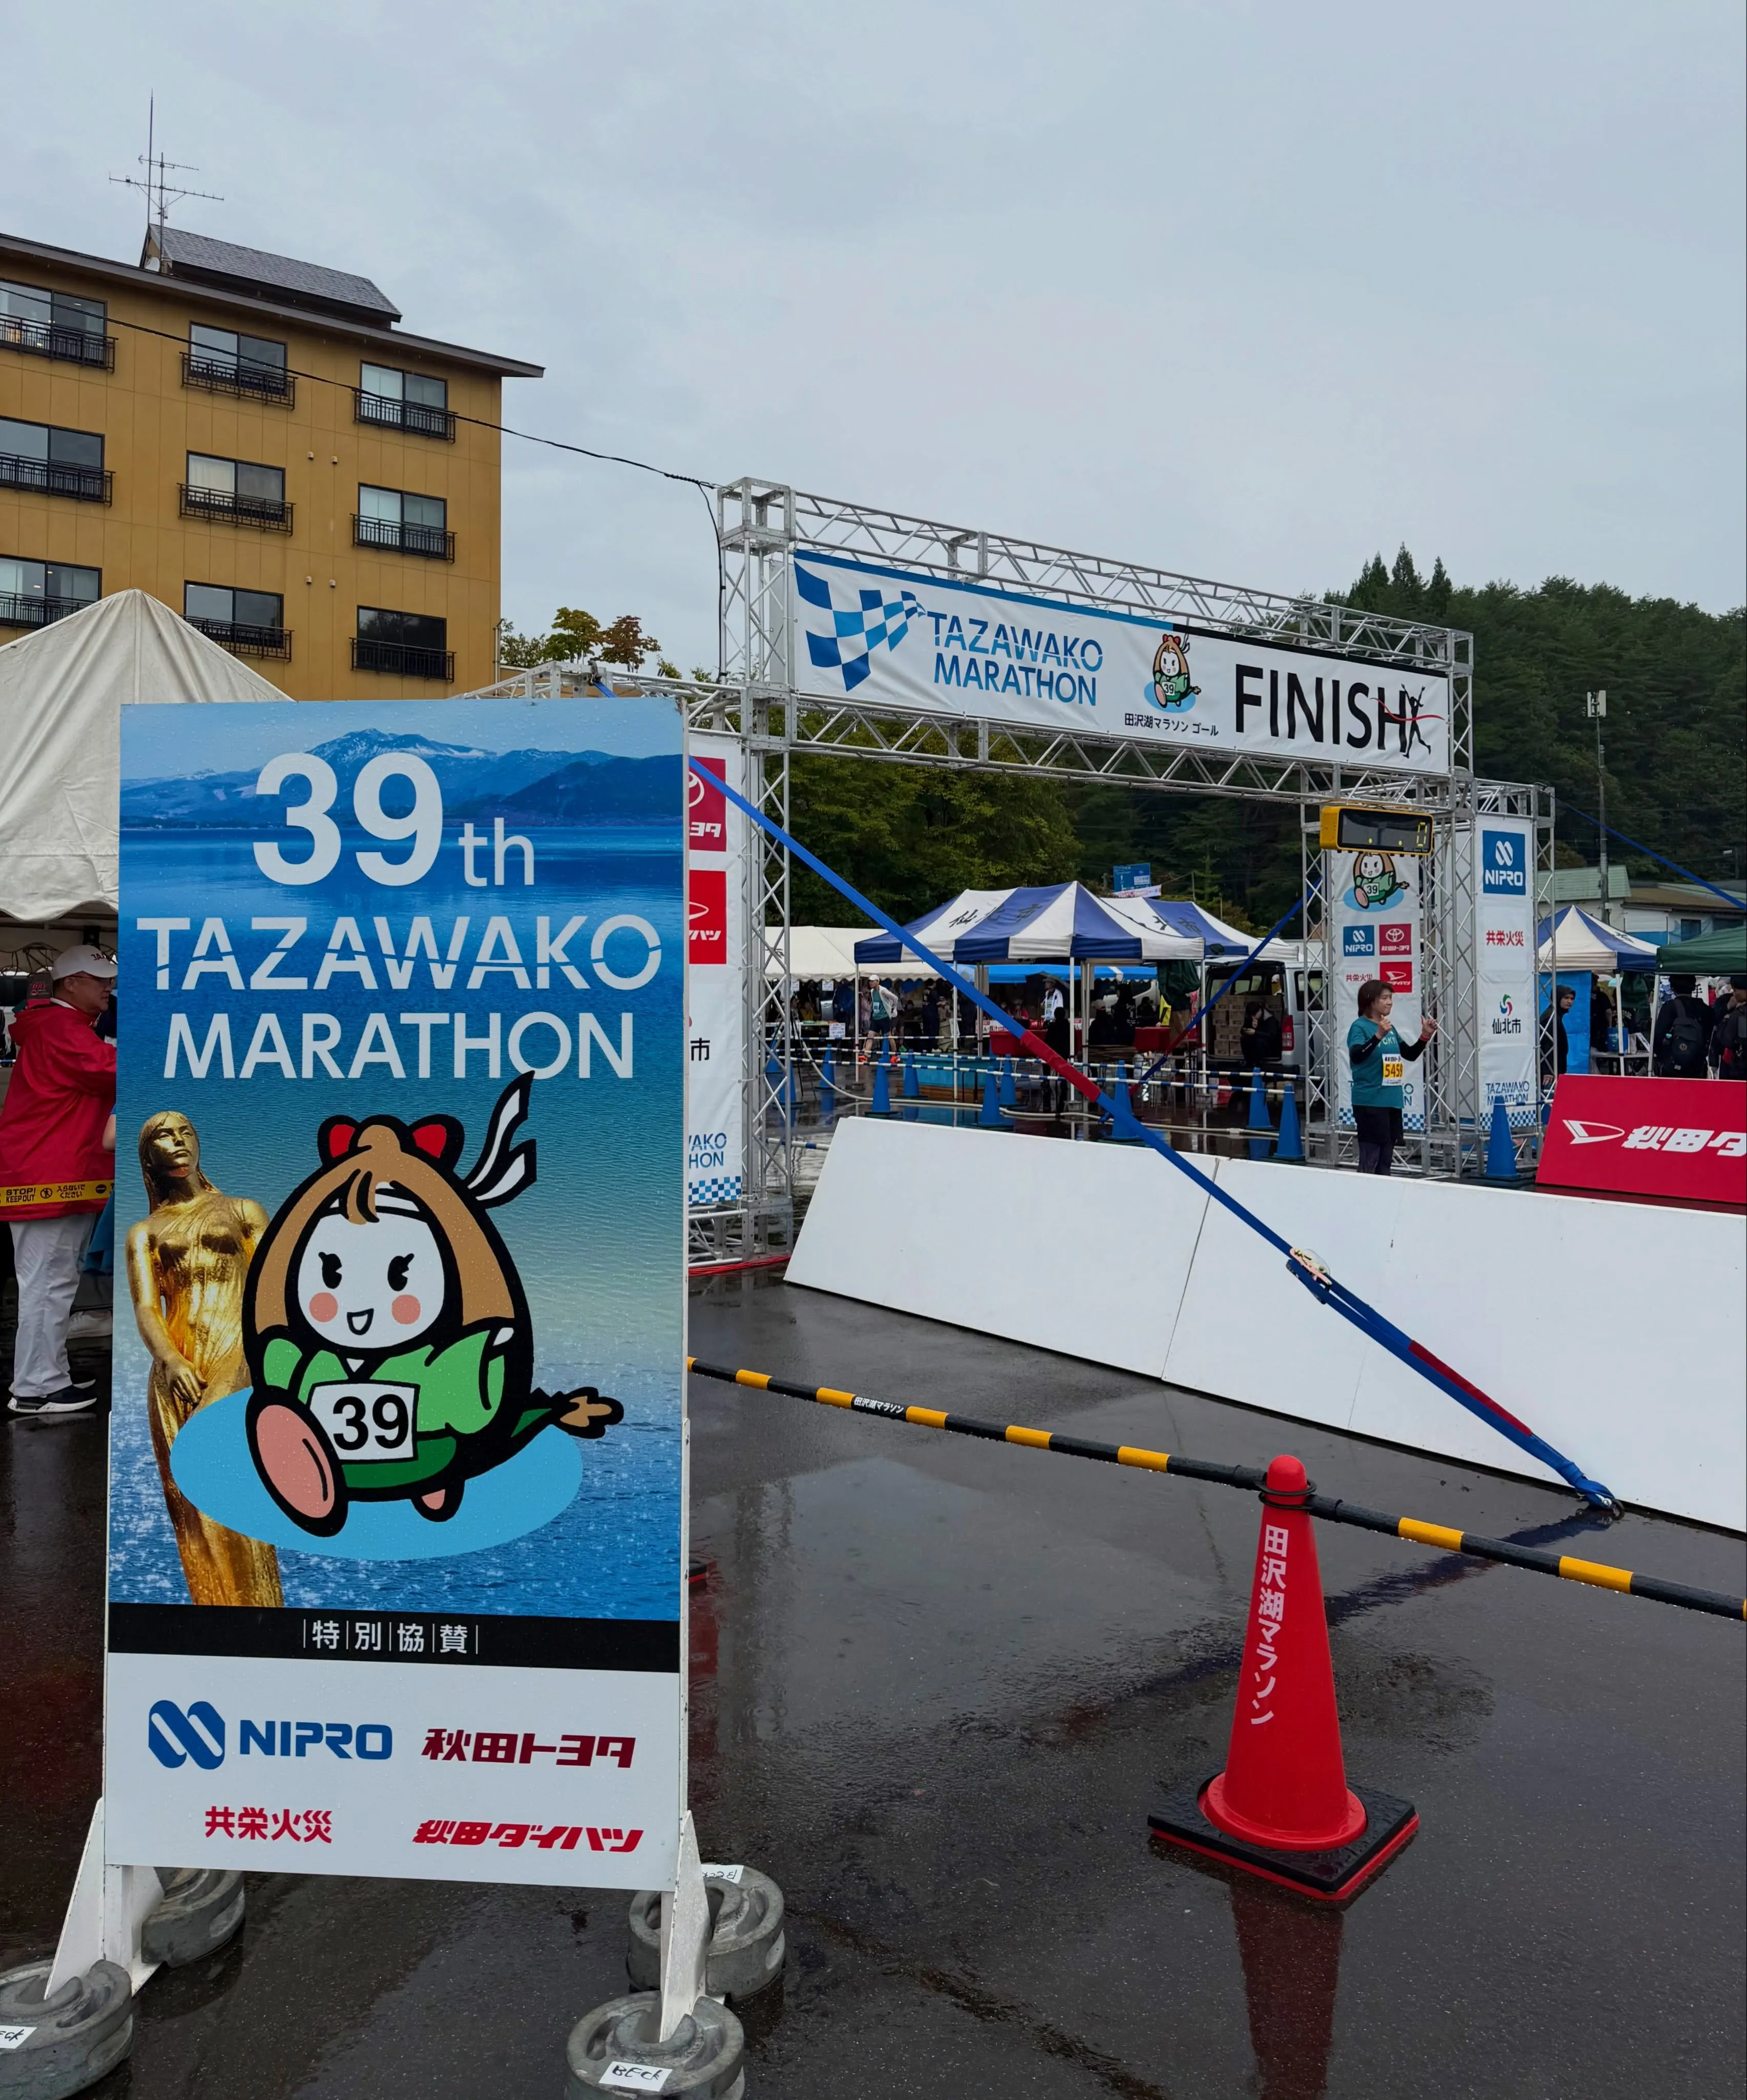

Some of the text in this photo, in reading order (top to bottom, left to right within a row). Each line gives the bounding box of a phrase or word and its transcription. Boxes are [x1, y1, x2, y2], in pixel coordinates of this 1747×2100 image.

[927, 611, 1103, 672] TAZAWAKO
[934, 652, 1096, 706] MARATHON
[1163, 683, 1174, 694] 39
[1124, 713, 1219, 736] 田沢湖マラソン ゴール
[1235, 663, 1407, 753] FINISH
[1366, 885, 1378, 895] 39
[1485, 869, 1523, 886] NIPRO
[136, 914, 662, 991] TAZAWAKO
[1345, 944, 1373, 953] NIPRO
[1486, 930, 1524, 947] 共栄火災
[1492, 1018, 1521, 1035] 仙北市
[162, 1011, 634, 1080] MARATHON
[1485, 1080, 1530, 1094] TAZAWAKO
[1487, 1093, 1529, 1106] MATHON
[6, 1187, 36, 1196] STOP!
[854, 1396, 904, 1414] 田沢湖マラソン
[333, 1394, 409, 1451] 39
[311, 1619, 469, 1654] 特別協賛
[1251, 1524, 1289, 1725] 田沢湖マラソン
[240, 1719, 393, 1761] NIPRO
[420, 1728, 636, 1769] 秋田トヨタ
[205, 1805, 333, 1844] 共栄火災
[412, 1819, 644, 1853] 秋田ダイハツ
